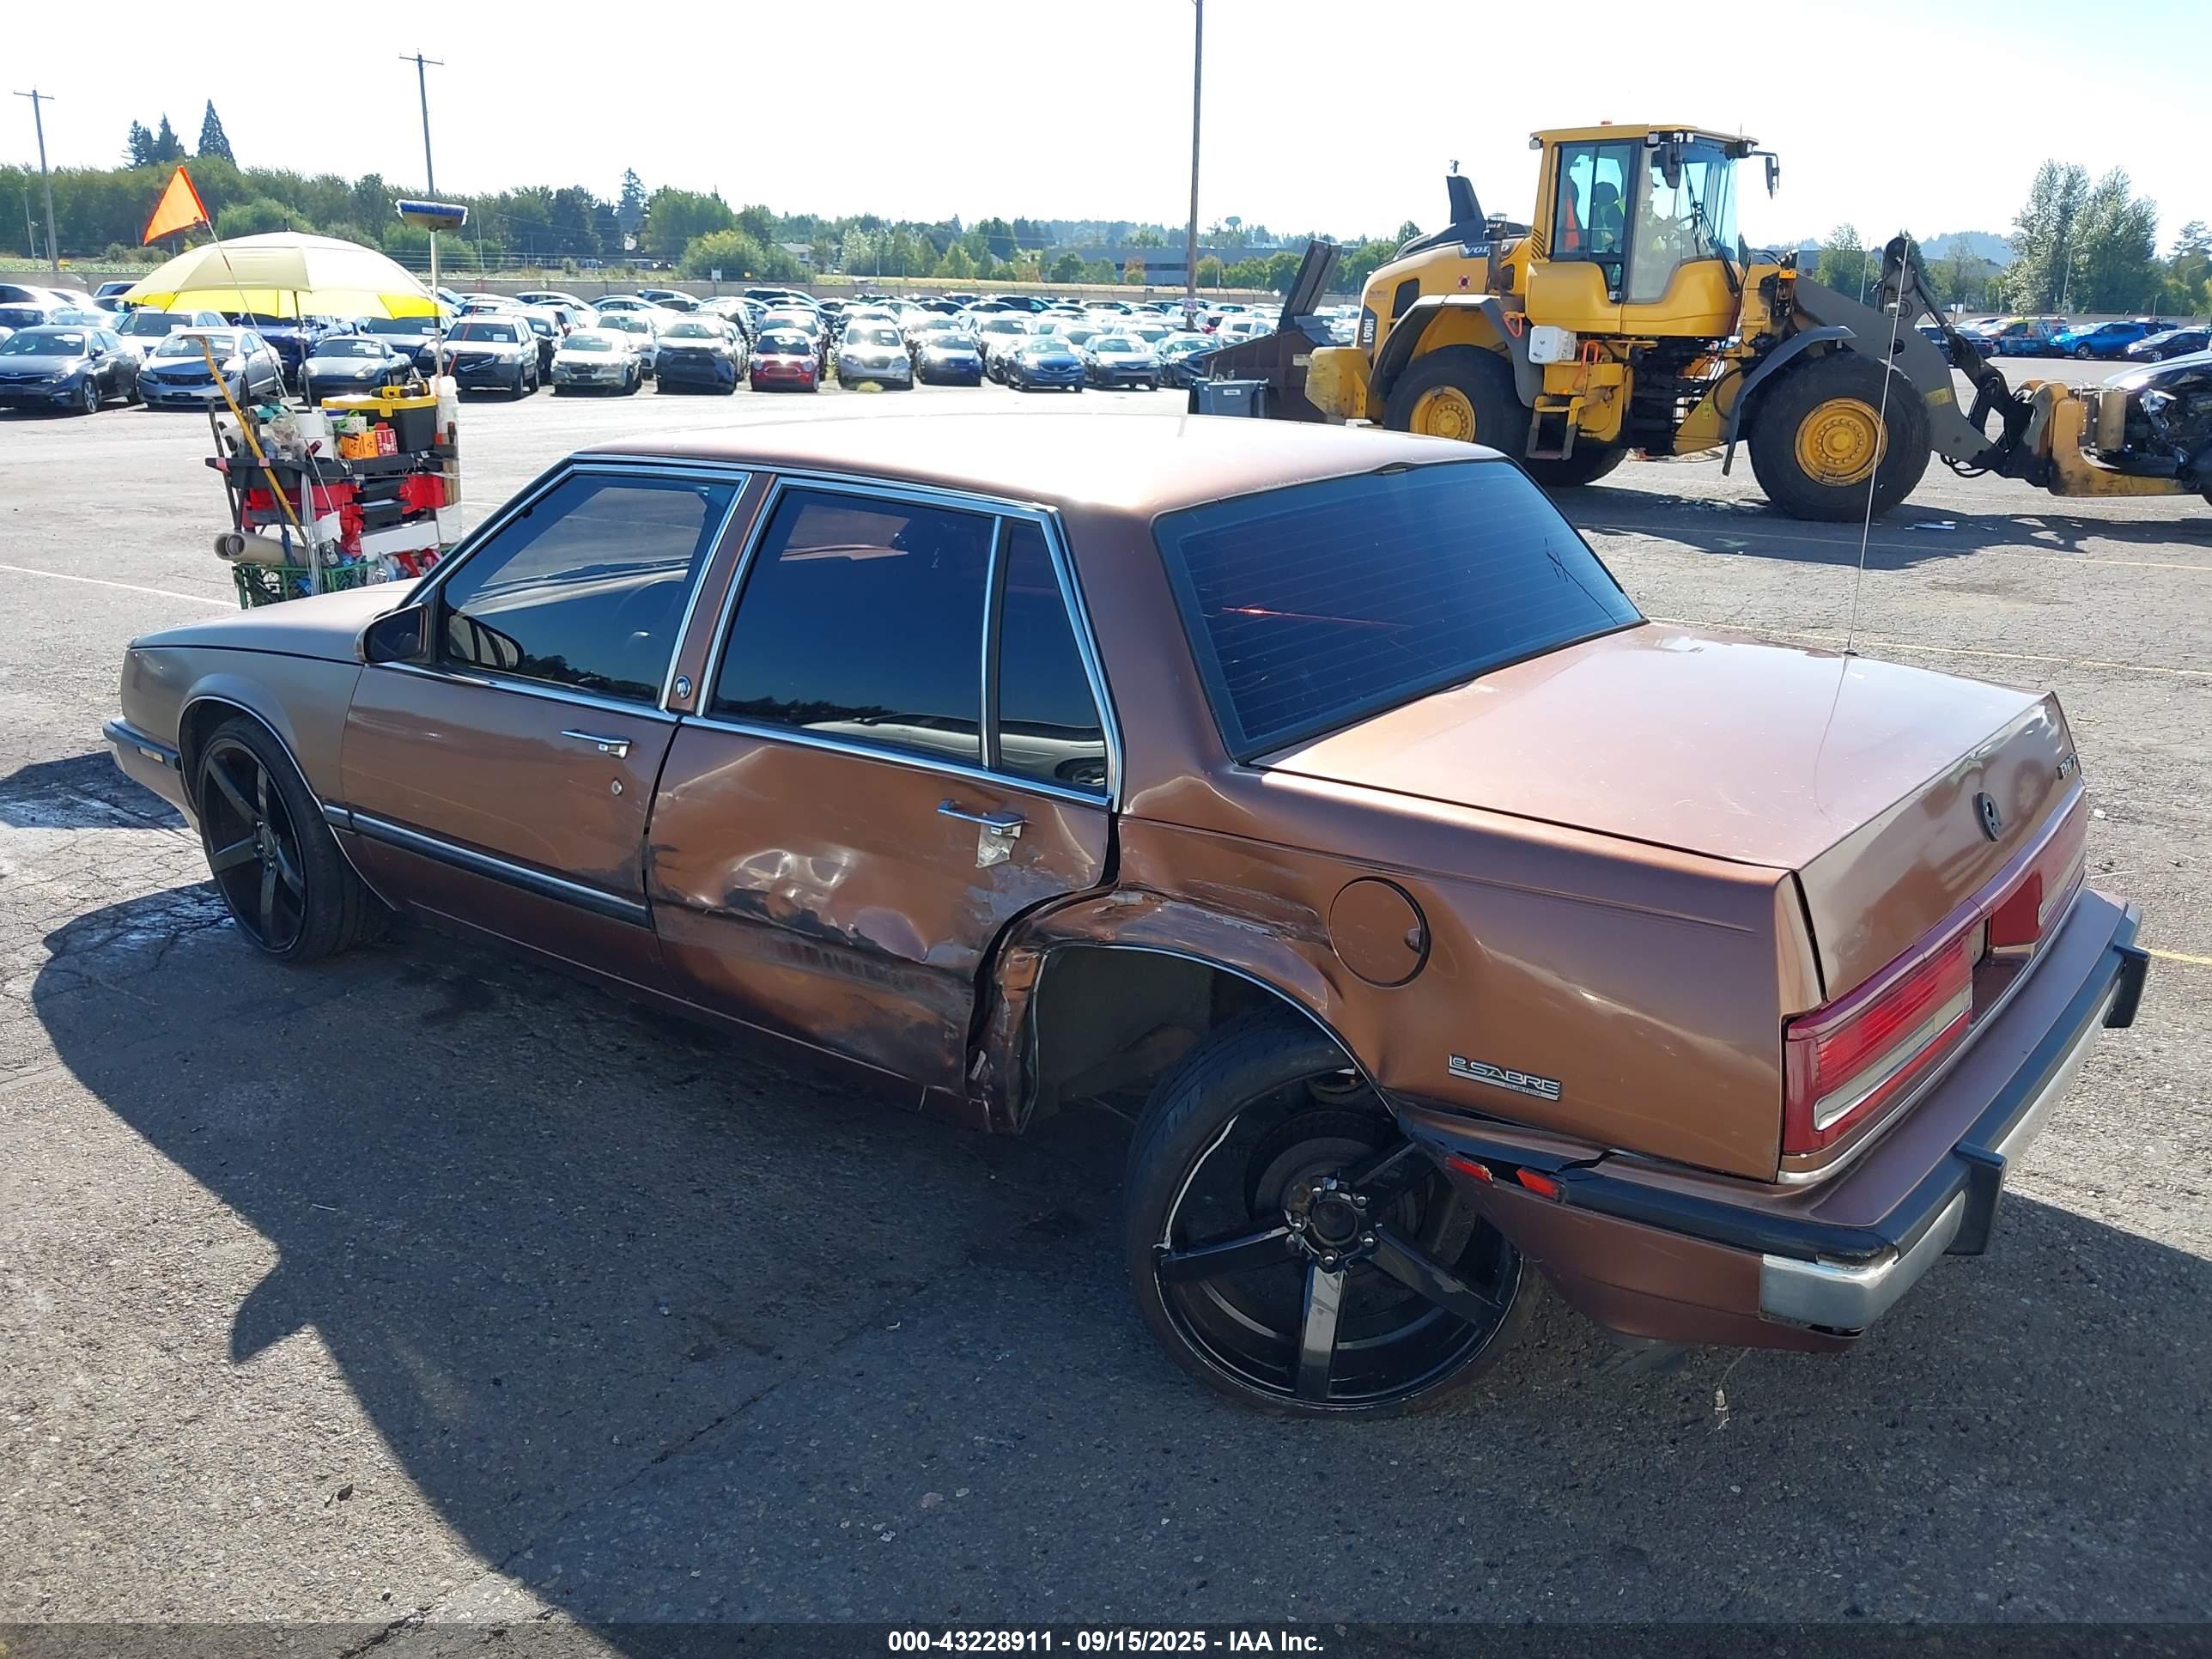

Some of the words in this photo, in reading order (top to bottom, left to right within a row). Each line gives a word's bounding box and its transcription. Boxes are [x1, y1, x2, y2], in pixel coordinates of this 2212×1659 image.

[1464, 244, 1510, 255] VOLO
[1363, 318, 1375, 343] L90H
[1504, 1082, 1542, 1097] CUSTOM
